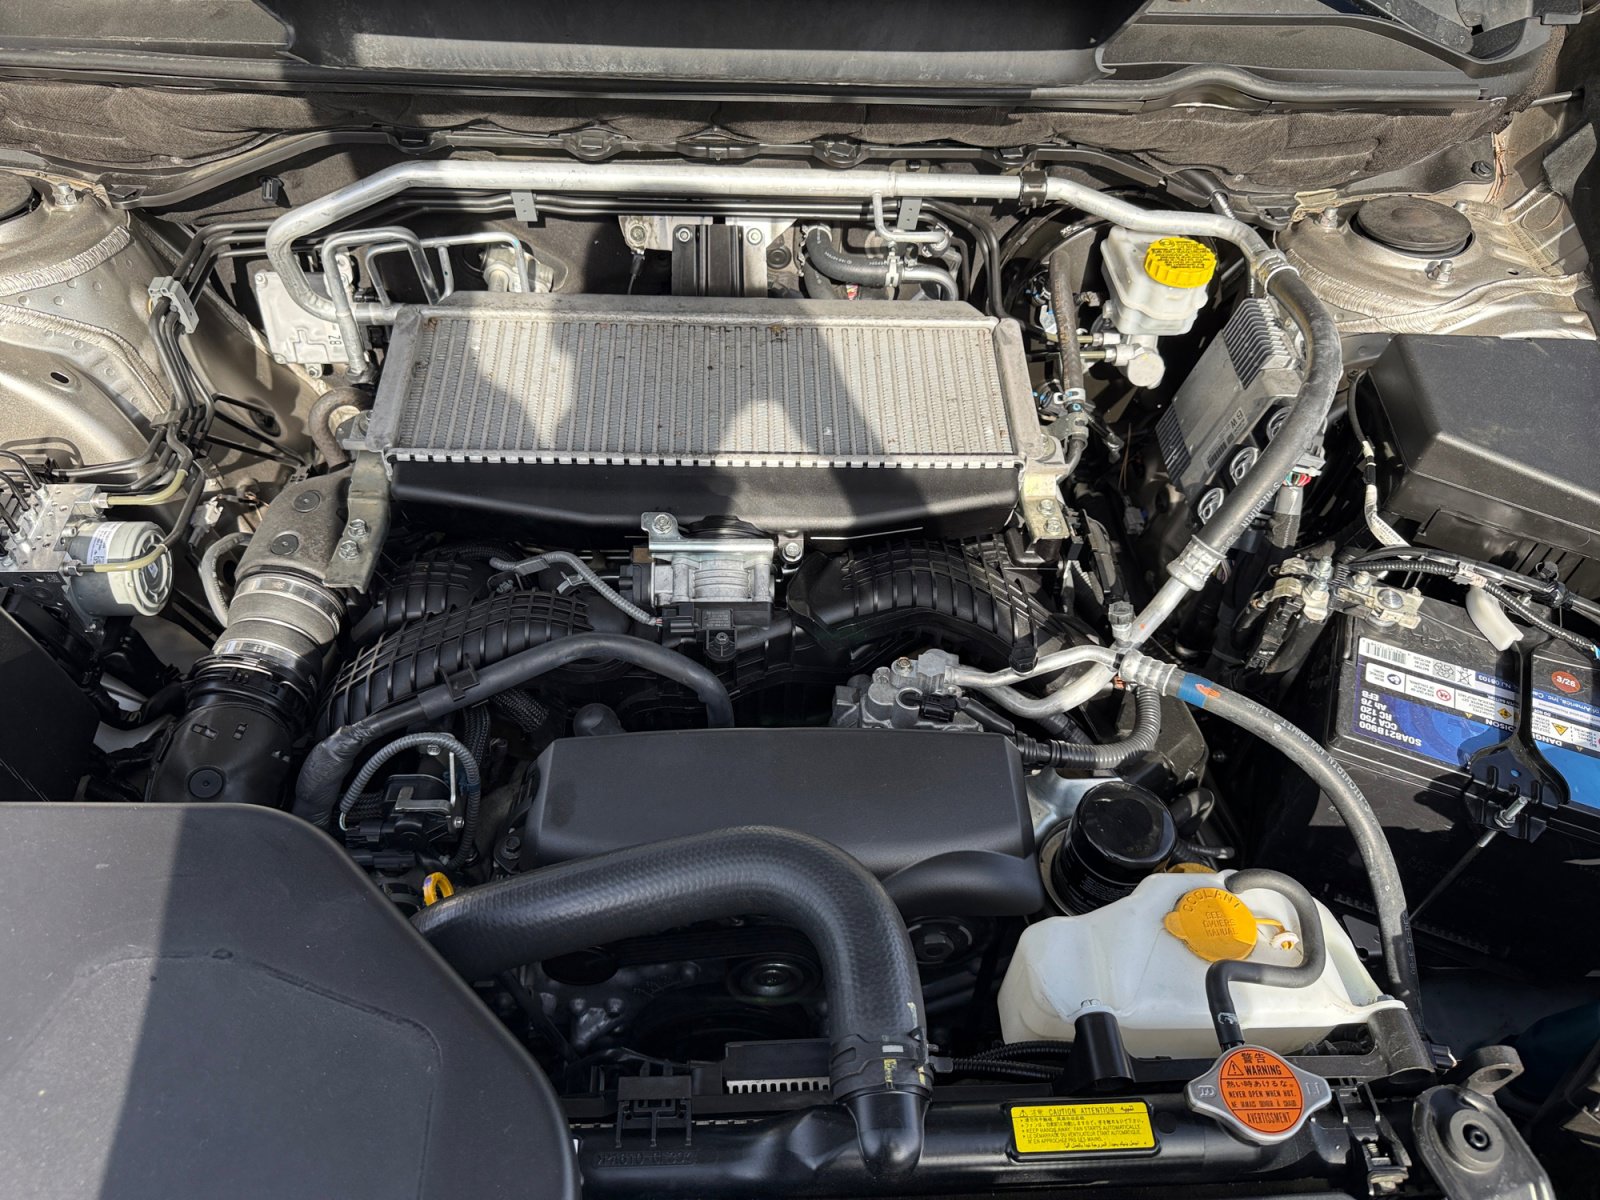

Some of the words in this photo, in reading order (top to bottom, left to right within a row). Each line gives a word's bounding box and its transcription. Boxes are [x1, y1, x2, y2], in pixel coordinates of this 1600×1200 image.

[1360, 705, 1376, 716] 120
[1374, 701, 1386, 711] Ah
[1359, 712, 1376, 724] 750
[1378, 710, 1392, 721] RC
[1378, 718, 1397, 731] CCA
[1241, 1053, 1266, 1064] 警告
[1244, 1065, 1282, 1075] WARNING
[1249, 1090, 1263, 1098] OPEN
[1049, 1108, 1076, 1116] CAUTION
[1081, 1107, 1115, 1115] ATTENTION
